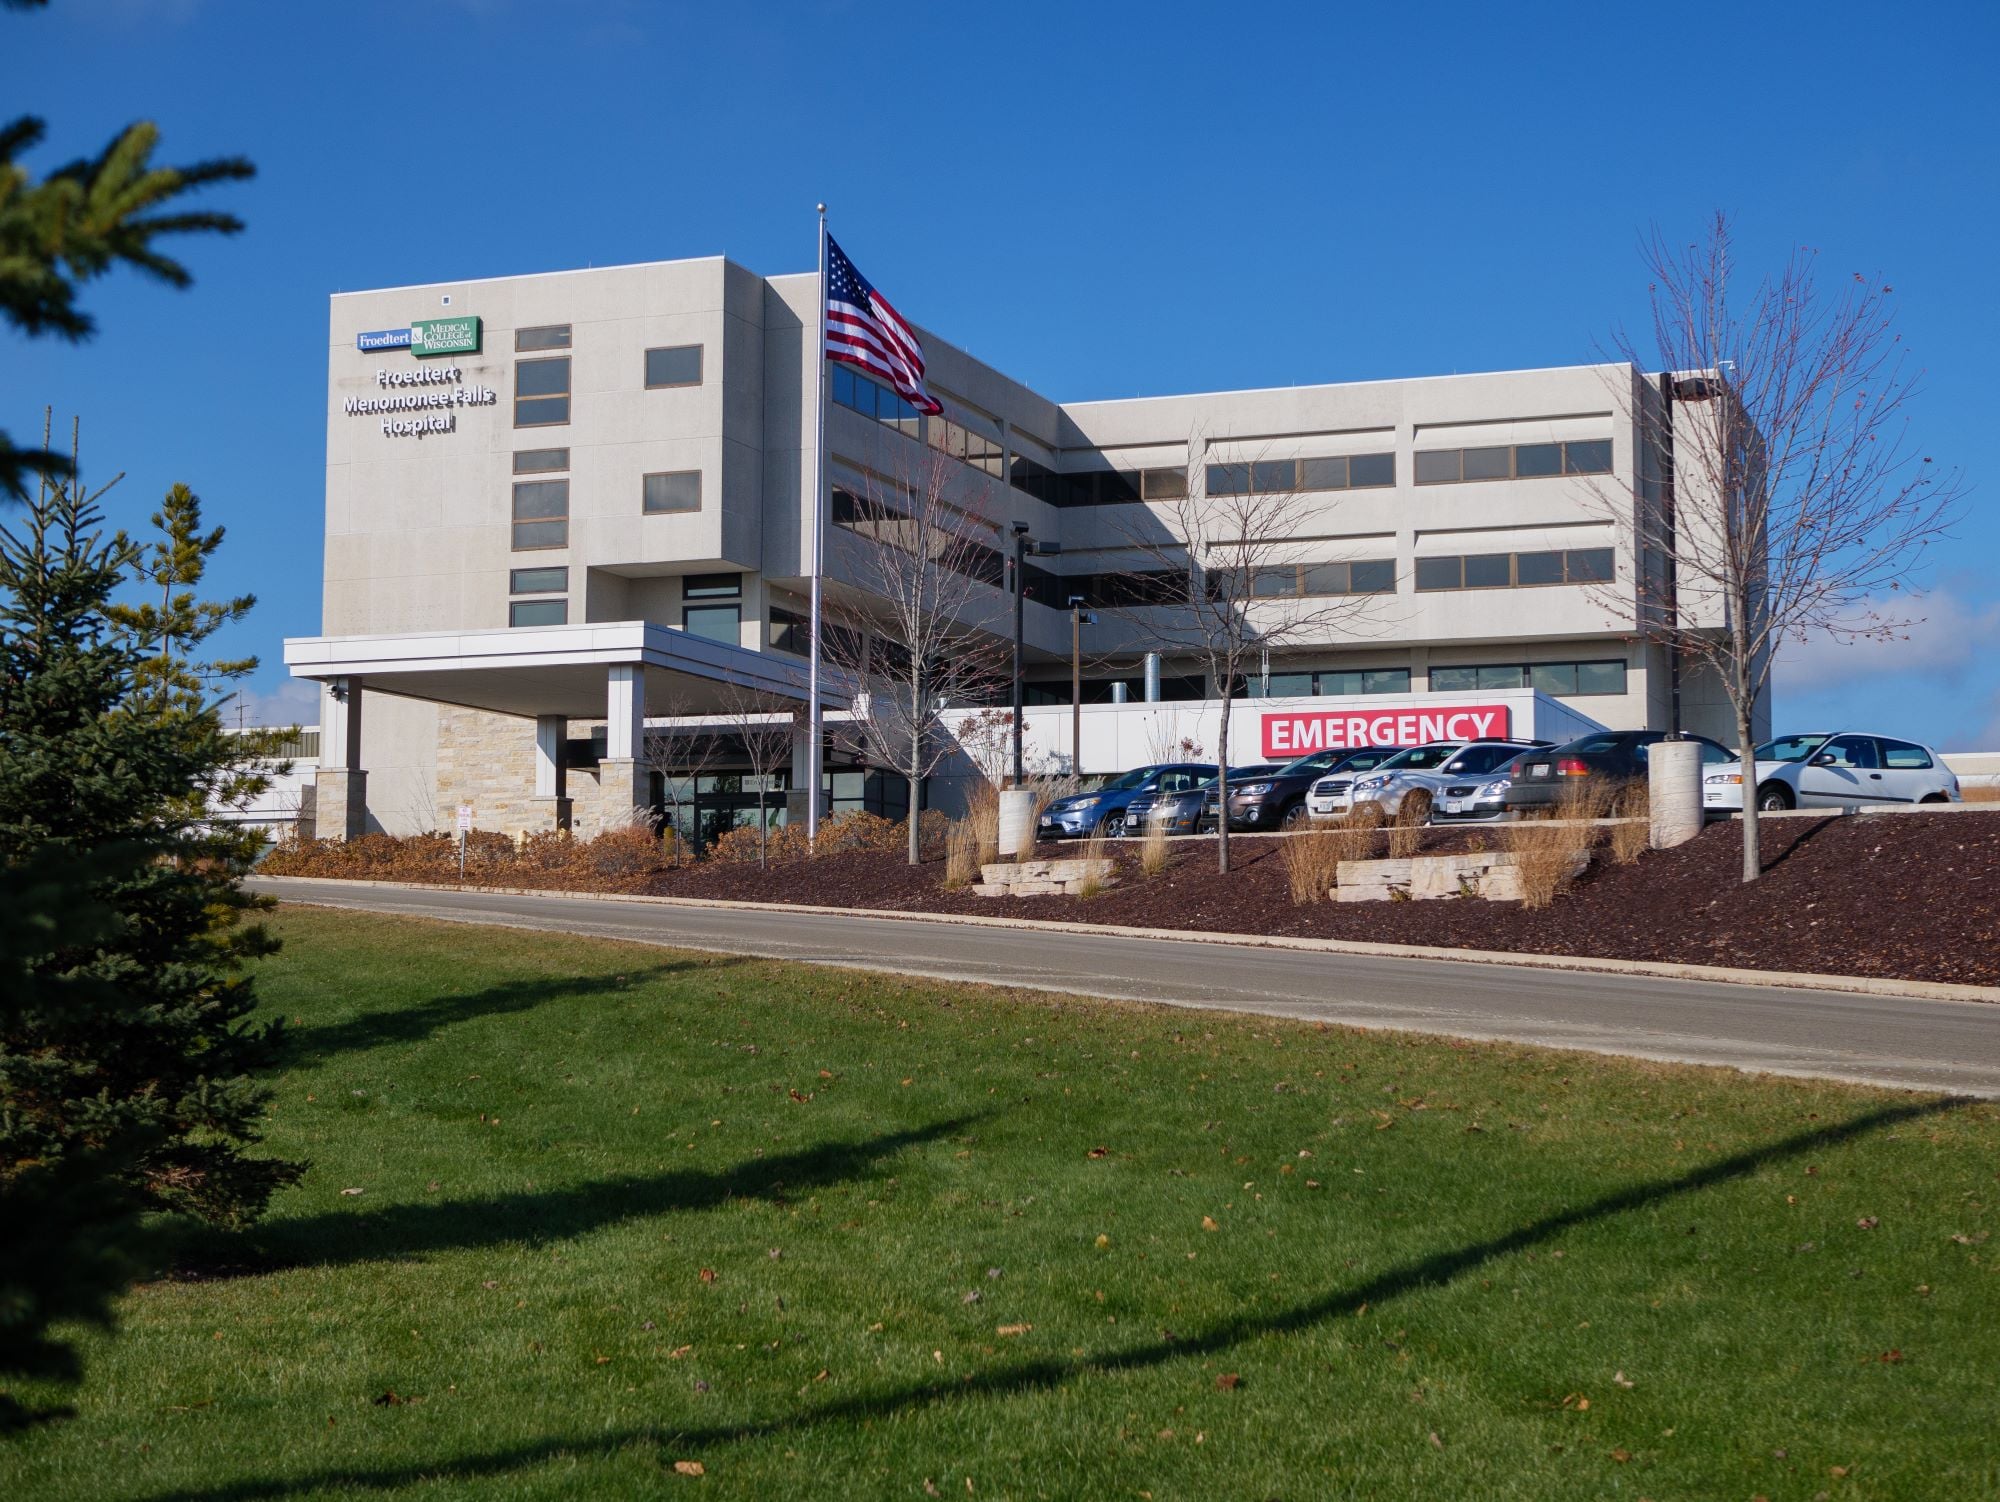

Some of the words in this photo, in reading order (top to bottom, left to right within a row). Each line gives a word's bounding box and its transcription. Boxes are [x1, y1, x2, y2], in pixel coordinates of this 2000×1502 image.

[430, 323, 470, 333] MEDICAL
[360, 333, 409, 346] Froedtert
[423, 332, 464, 341] COLLEGE
[424, 338, 473, 349] WISCONSIN
[376, 365, 456, 385] Froedtert
[343, 392, 452, 412] Menomonee
[453, 385, 492, 403] Falls
[380, 412, 450, 436] Hospital
[1271, 712, 1495, 749] EMERGENCY
